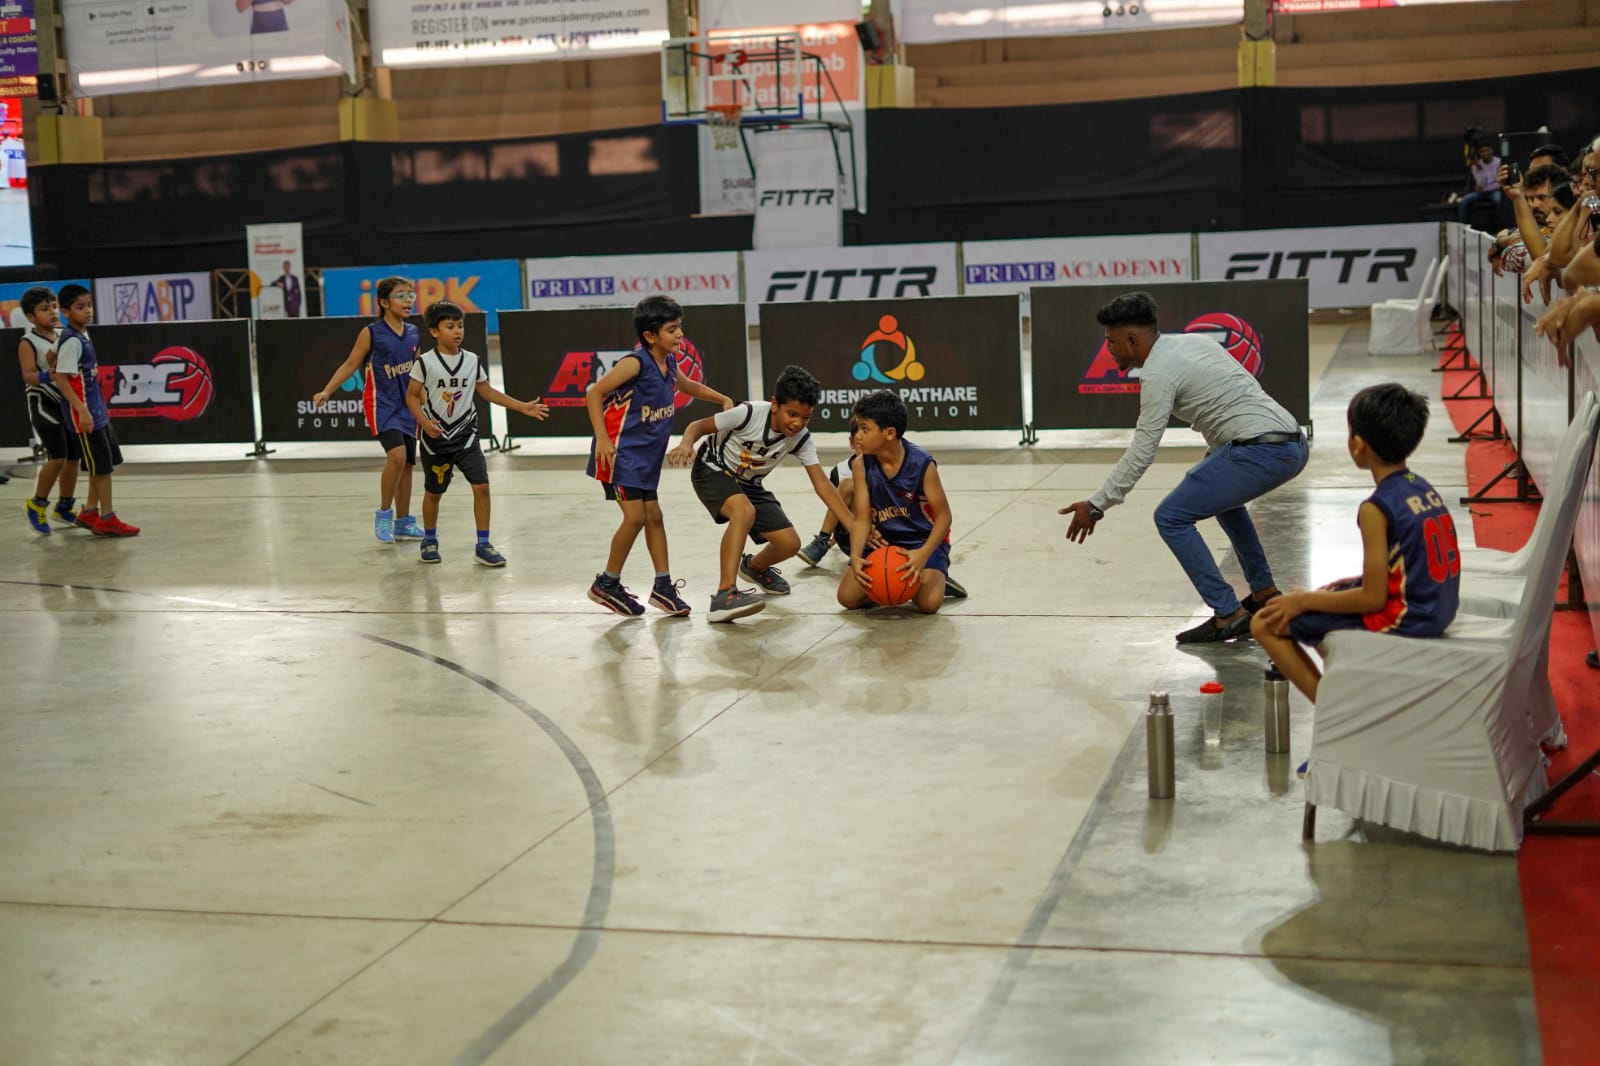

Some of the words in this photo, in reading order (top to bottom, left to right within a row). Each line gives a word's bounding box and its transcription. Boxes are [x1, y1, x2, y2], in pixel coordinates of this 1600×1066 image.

[412, 16, 469, 36] REGISTER
[471, 15, 489, 32] ON
[760, 188, 834, 207] FITTR
[968, 263, 1055, 283] PRIME
[1059, 257, 1185, 279] ACADEMY
[1225, 247, 1417, 284] FITTR
[533, 277, 614, 297] PRIME
[618, 272, 732, 293] ACADEMY
[766, 265, 938, 302] FITTR
[899, 386, 977, 403] PATHARE
